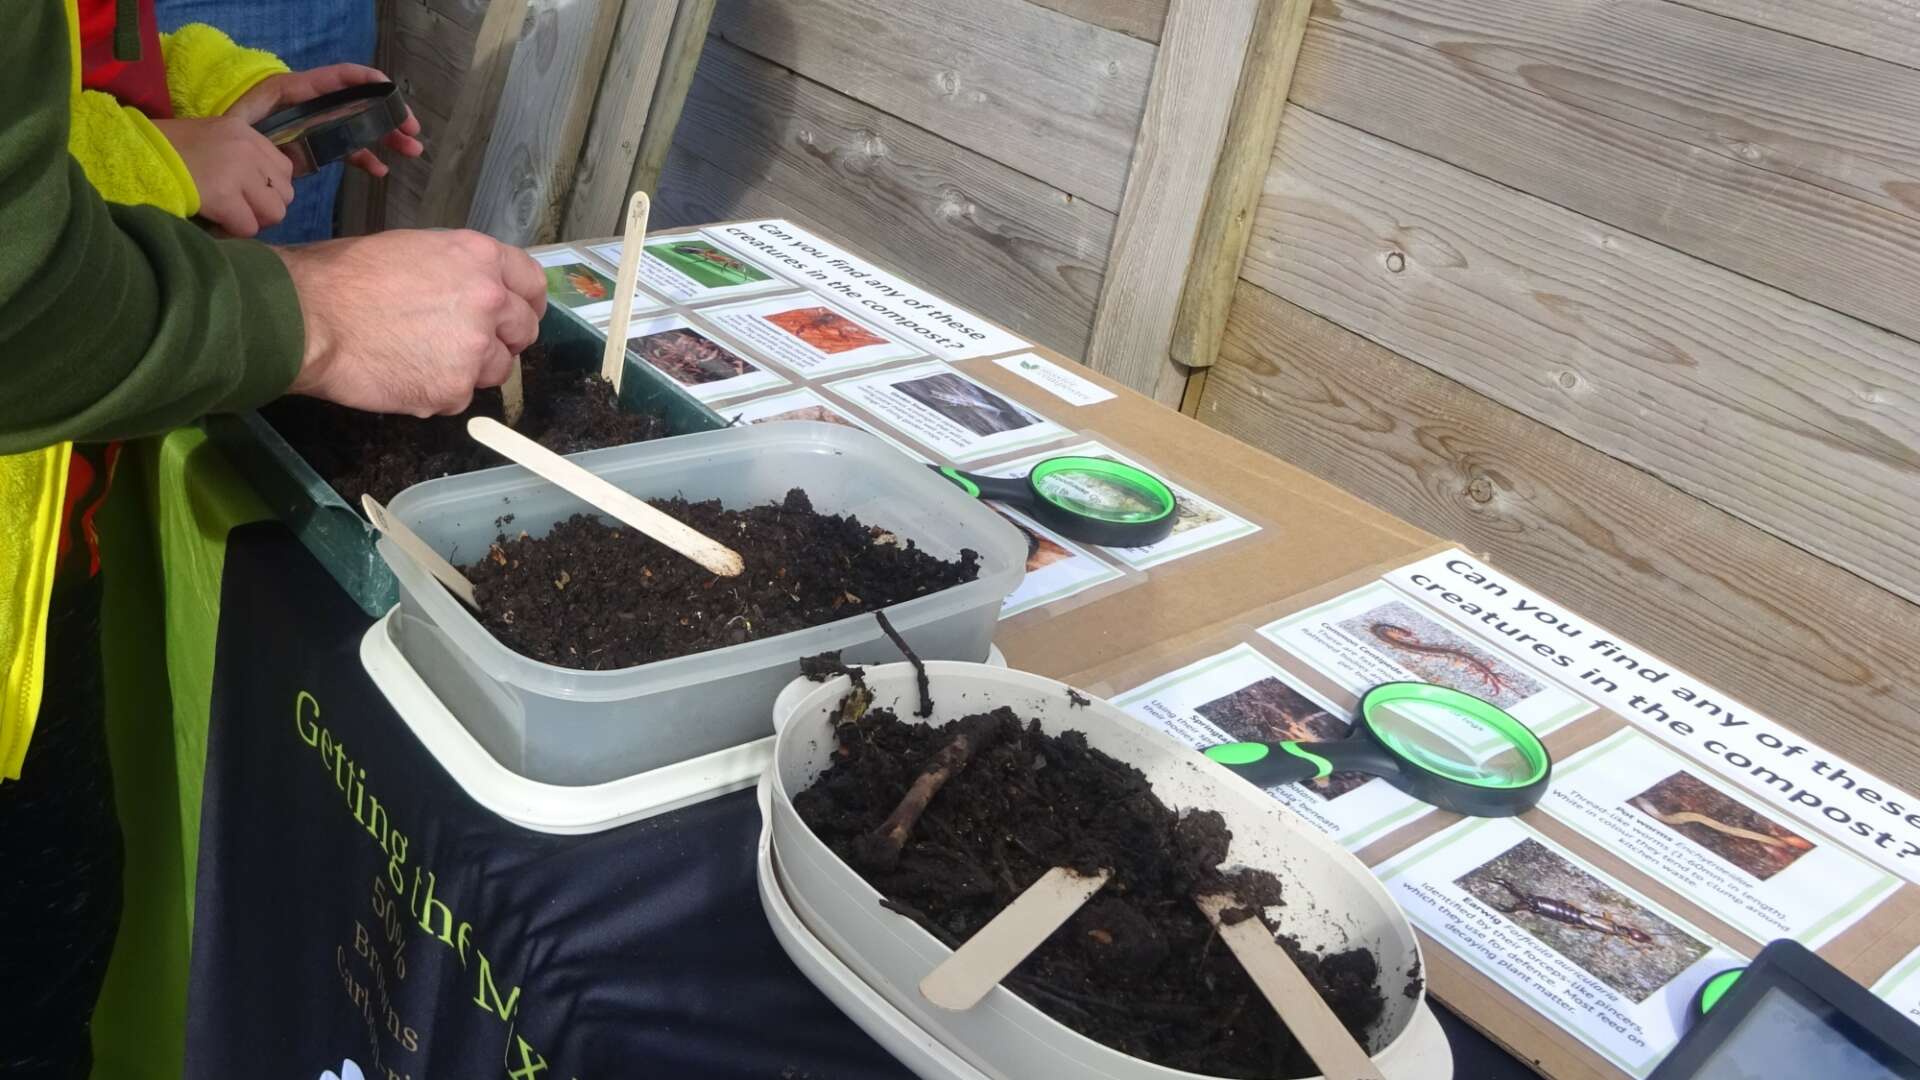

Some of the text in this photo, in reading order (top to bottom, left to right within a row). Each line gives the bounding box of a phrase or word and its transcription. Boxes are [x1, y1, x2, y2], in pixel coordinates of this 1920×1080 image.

[725, 227, 809, 270] creatures
[804, 269, 829, 281] in
[826, 281, 863, 298] the
[860, 299, 965, 349] compost?
[758, 224, 987, 341] Can you find any of these
[1410, 574, 1920, 859] creatures in the compost?
[1445, 559, 1920, 830] Can you find any of these
[296, 690, 409, 895] Getting
[1552, 789, 1791, 932] White in colour they tend to clump around
[1569, 789, 1787, 922] Thread-like worms (1-60mm in length).
[1617, 837, 1697, 889] kitchen waste.
[1402, 882, 1646, 1048] which they use for defence. Most feed on
[1420, 881, 1644, 1036] Identified by their forceps-like pincers,
[1444, 923, 1576, 1015] decaying plant matter.
[1461, 896, 1619, 1003] Earwig Forficula auricularia
